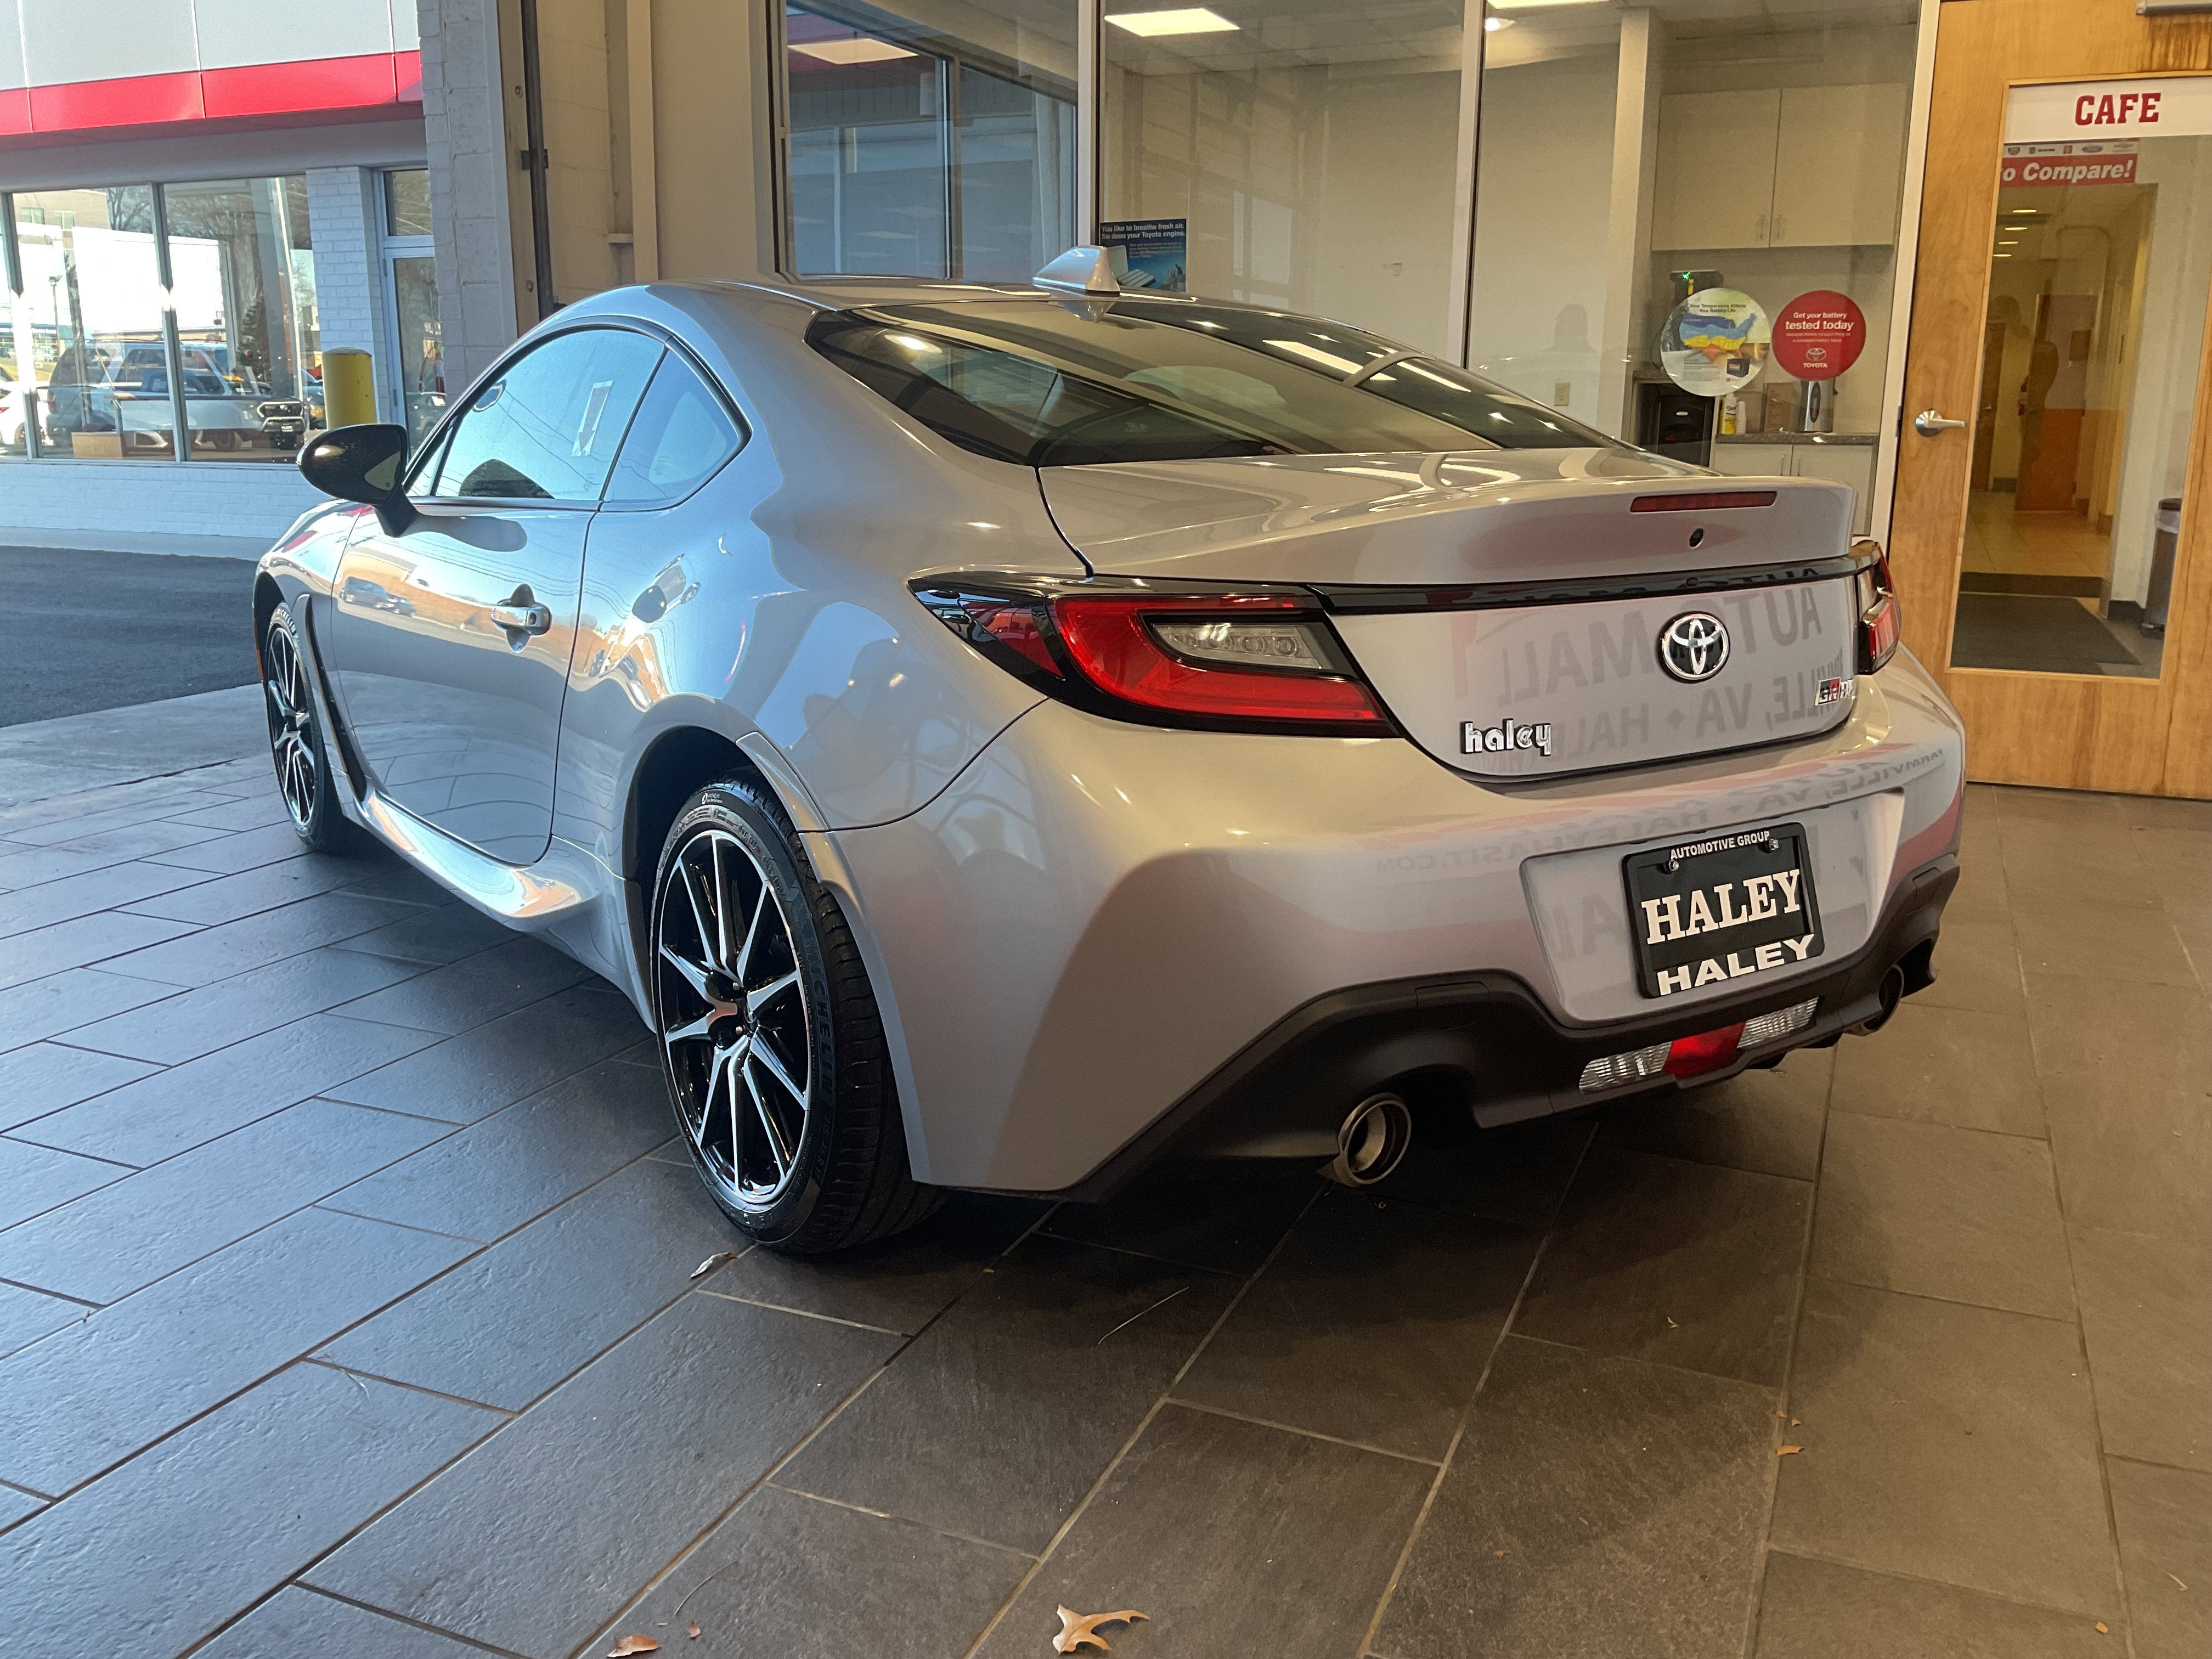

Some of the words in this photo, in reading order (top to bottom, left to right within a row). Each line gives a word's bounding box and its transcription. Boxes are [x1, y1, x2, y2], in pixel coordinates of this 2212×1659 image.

[2075, 92, 2162, 126] CAFE
[2001, 167, 2016, 182] o
[2023, 159, 2134, 184] Compare!
[1141, 231, 1162, 239] Toyota
[1785, 320, 1820, 330] tested
[1822, 320, 1854, 331] today
[1822, 312, 1848, 320] battery
[1462, 718, 1552, 757] haley
[1671, 837, 1735, 860] AUTOMOTIVE
[1737, 831, 1770, 847] GROUP
[1641, 868, 1801, 945] HALEY
[1657, 933, 1815, 996] HALEY
